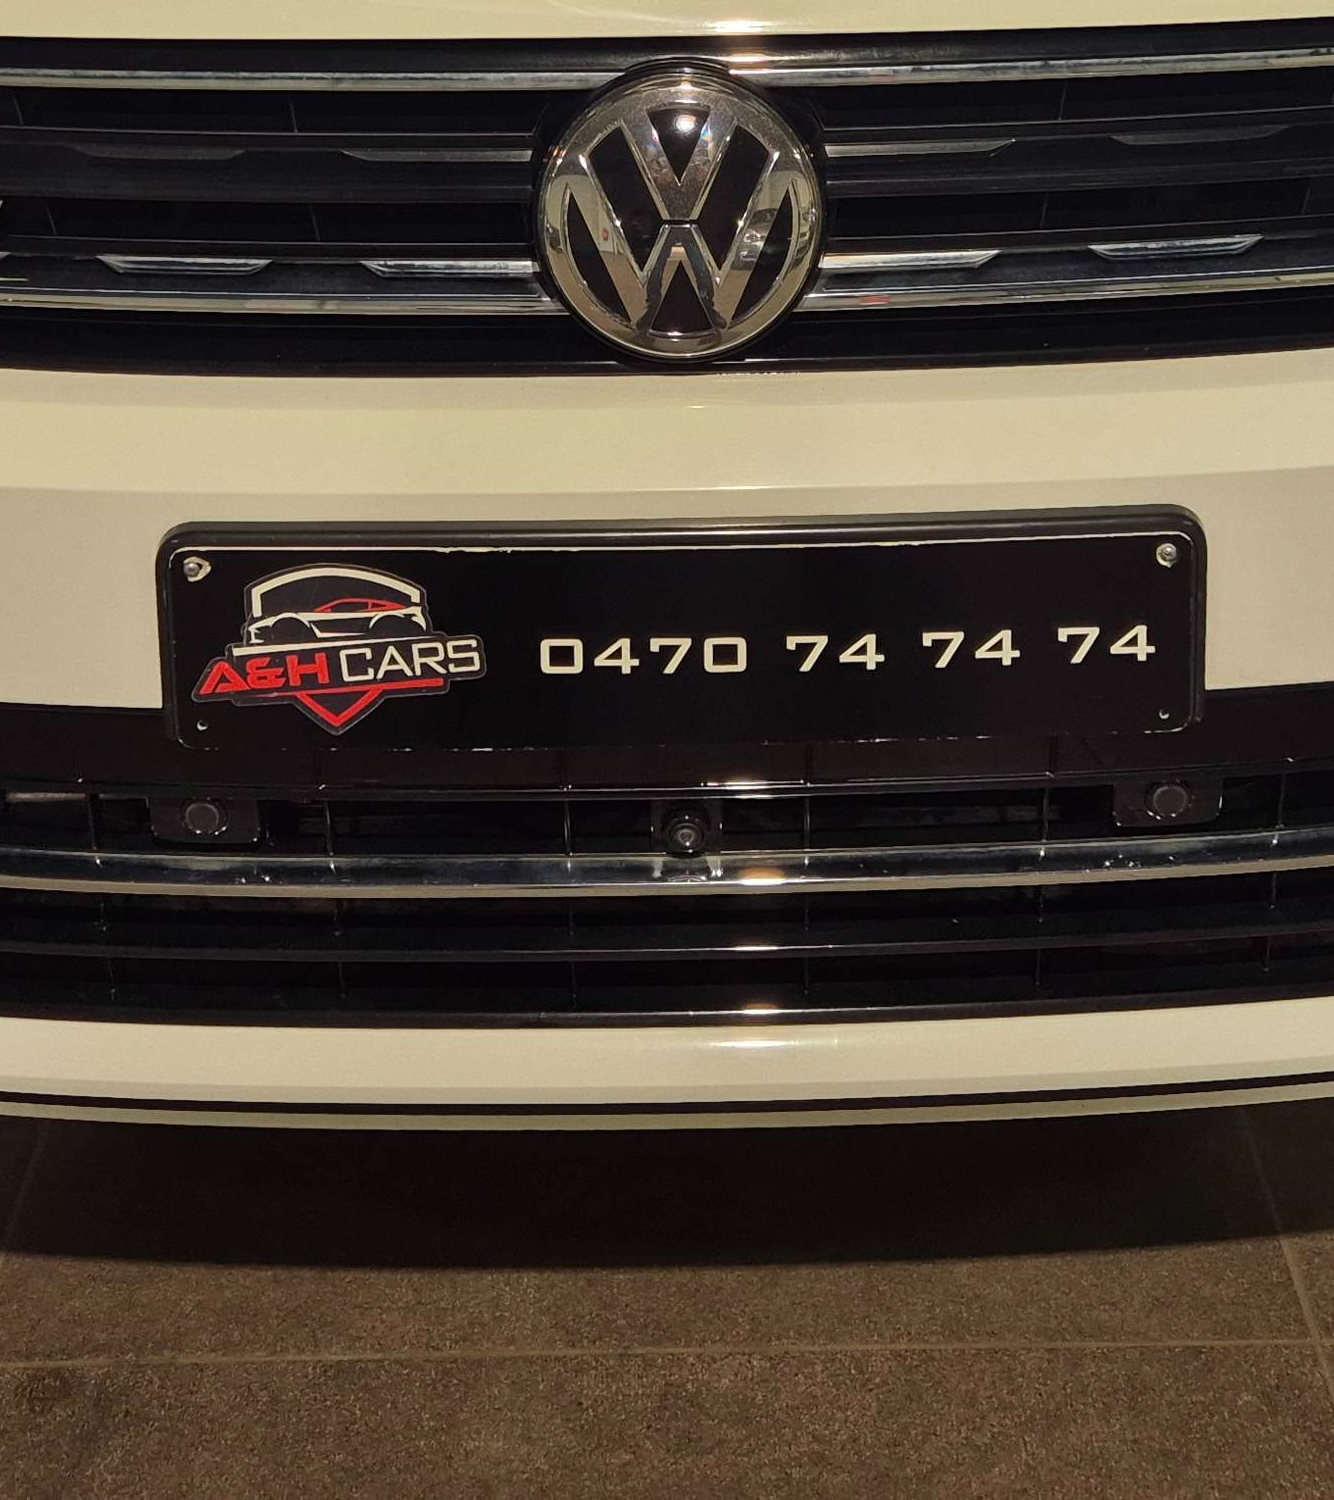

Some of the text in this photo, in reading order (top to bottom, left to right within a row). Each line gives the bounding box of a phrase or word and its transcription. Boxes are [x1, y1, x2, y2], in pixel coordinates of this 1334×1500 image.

[199, 638, 481, 695] A&H CARS
[540, 625, 1156, 675] 0470 74 74 74
